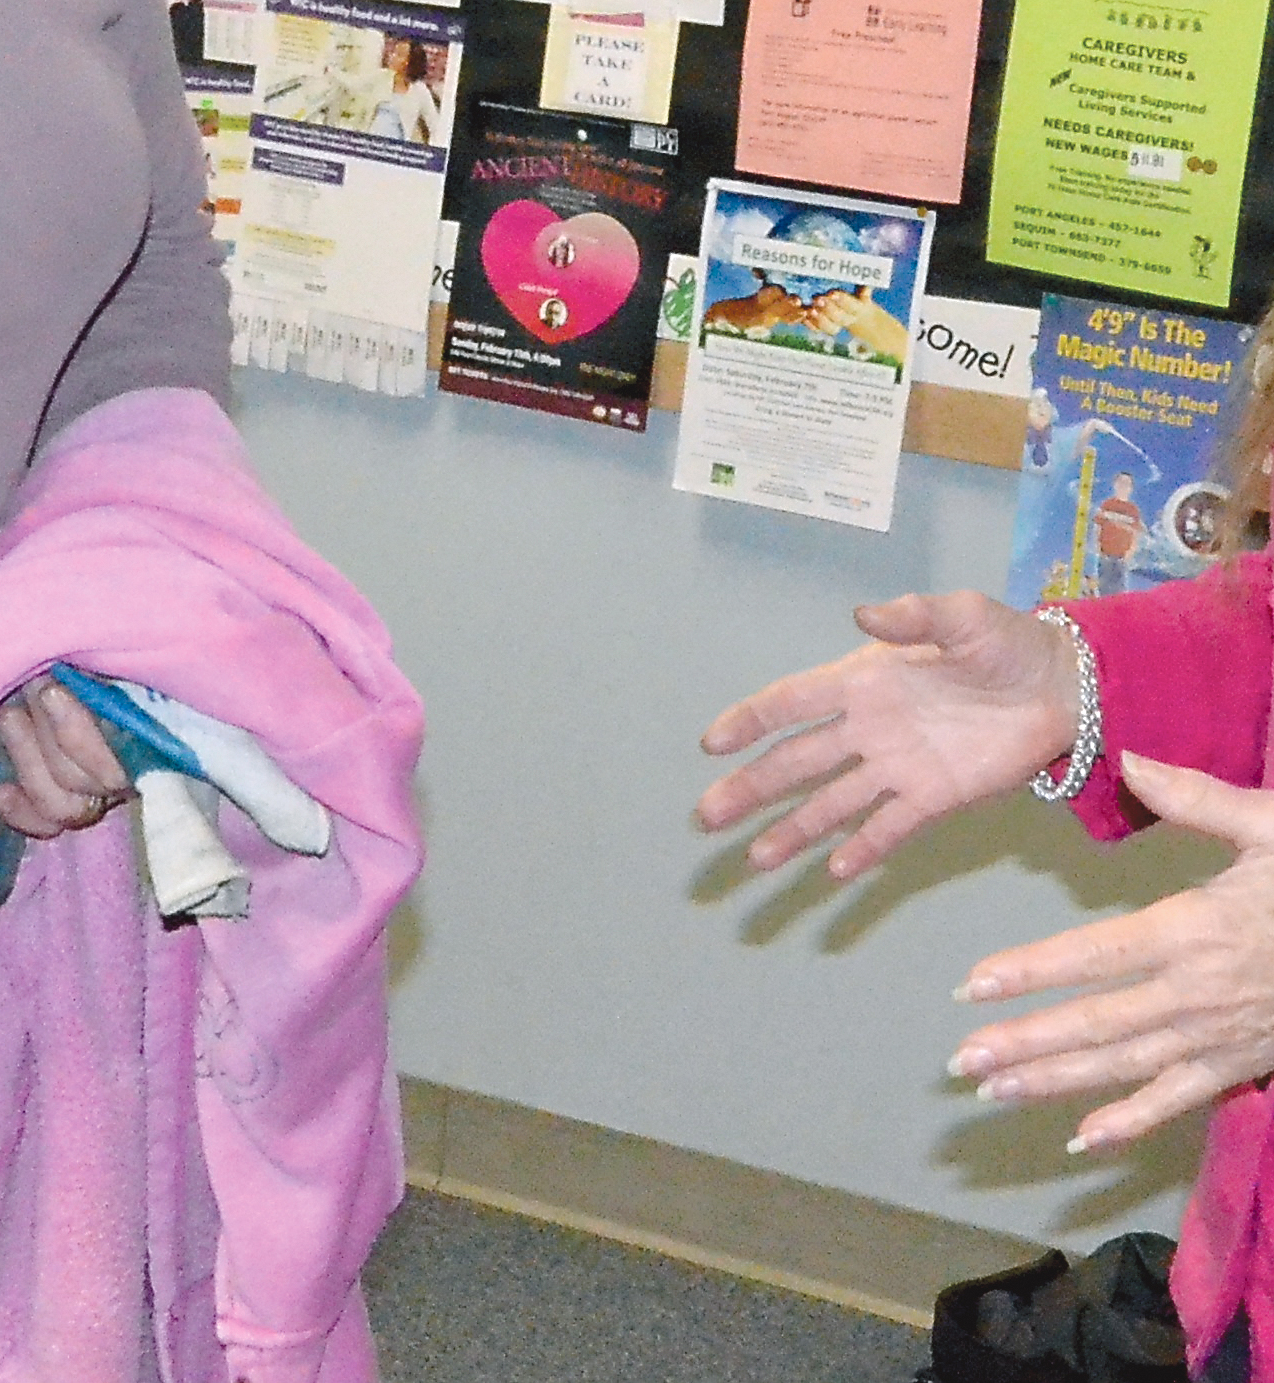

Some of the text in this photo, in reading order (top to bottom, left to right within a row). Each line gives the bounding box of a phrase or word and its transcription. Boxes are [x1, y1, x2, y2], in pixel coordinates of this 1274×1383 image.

[574, 33, 644, 53] PLEASE
[1082, 36, 1188, 65] CAREGIVERS
[582, 54, 633, 71] TAKE
[1069, 52, 1196, 81] HOME CARE TEAM &
[598, 74, 610, 87] A
[1069, 83, 1207, 115] Caregivers Supported
[1078, 99, 1173, 124] Living Services
[1043, 116, 1195, 153] NEEDS CAREGIVERS!
[1045, 137, 1128, 161] NEW WAGES
[471, 155, 571, 181] ANCIENT
[1013, 221, 1056, 236] SEQUIM
[1014, 204, 1096, 227] PORT ANGELES
[740, 243, 882, 282] Reasons for Hope
[1012, 237, 1106, 263] PORT TOWNSEND
[1140, 316, 1158, 340] Is
[1163, 318, 1207, 350] The
[1057, 333, 1232, 384] Magic Number!
[766, 375, 802, 389] February
[1060, 376, 1220, 417] Until Then, Kids Need
[1081, 398, 1194, 428] A Booster Seat
